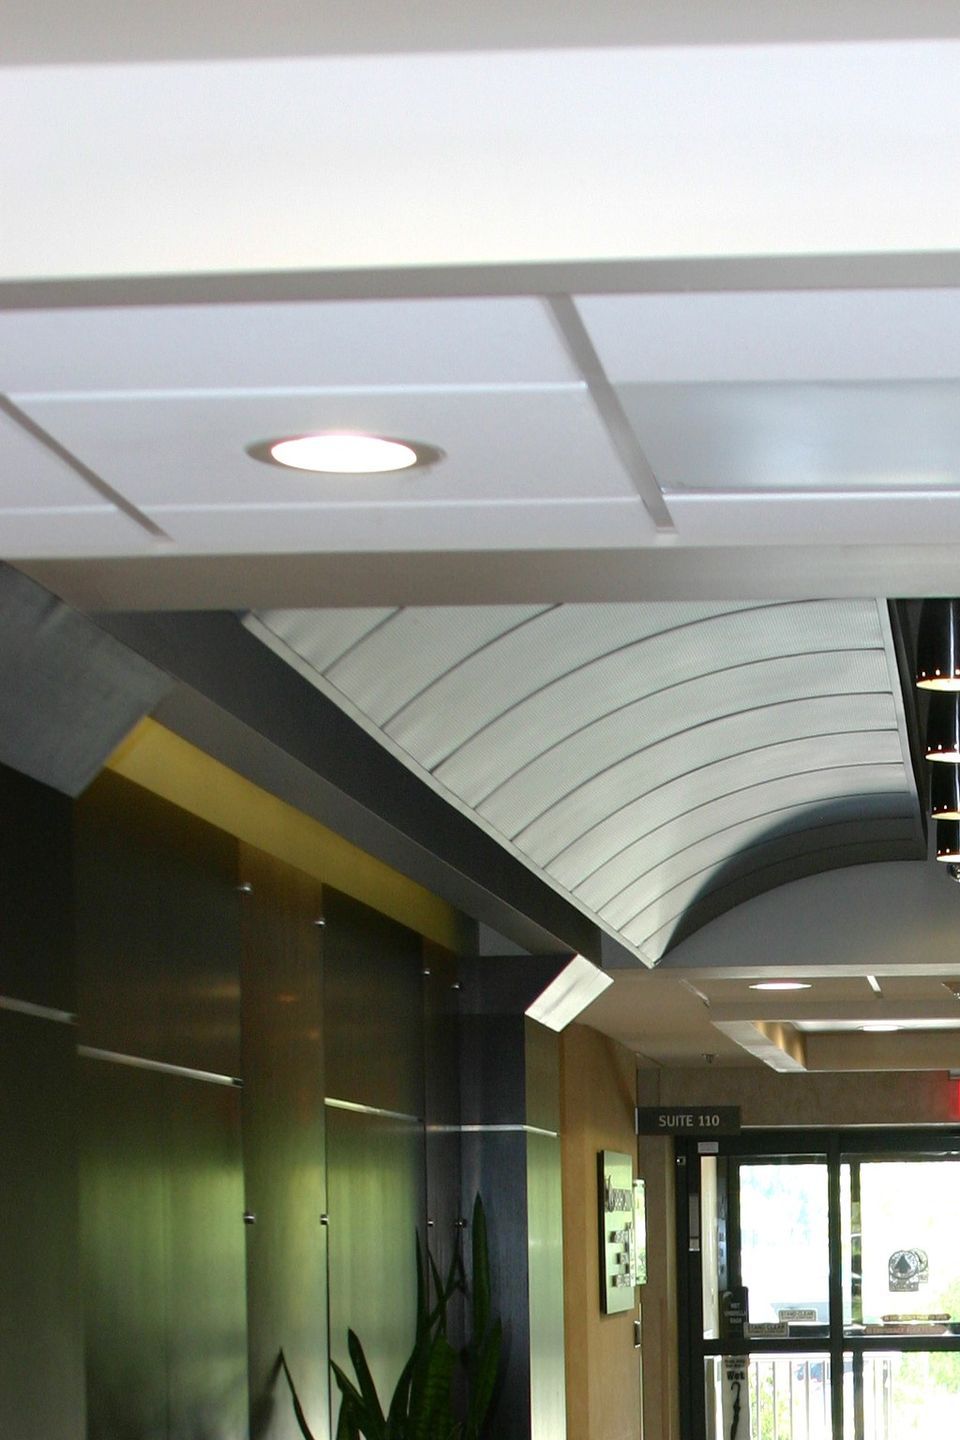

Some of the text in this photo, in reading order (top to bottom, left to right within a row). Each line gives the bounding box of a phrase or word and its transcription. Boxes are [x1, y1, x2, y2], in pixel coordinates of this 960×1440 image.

[658, 1114, 720, 1128] SUITE 110
[727, 1371, 745, 1380] Wet
